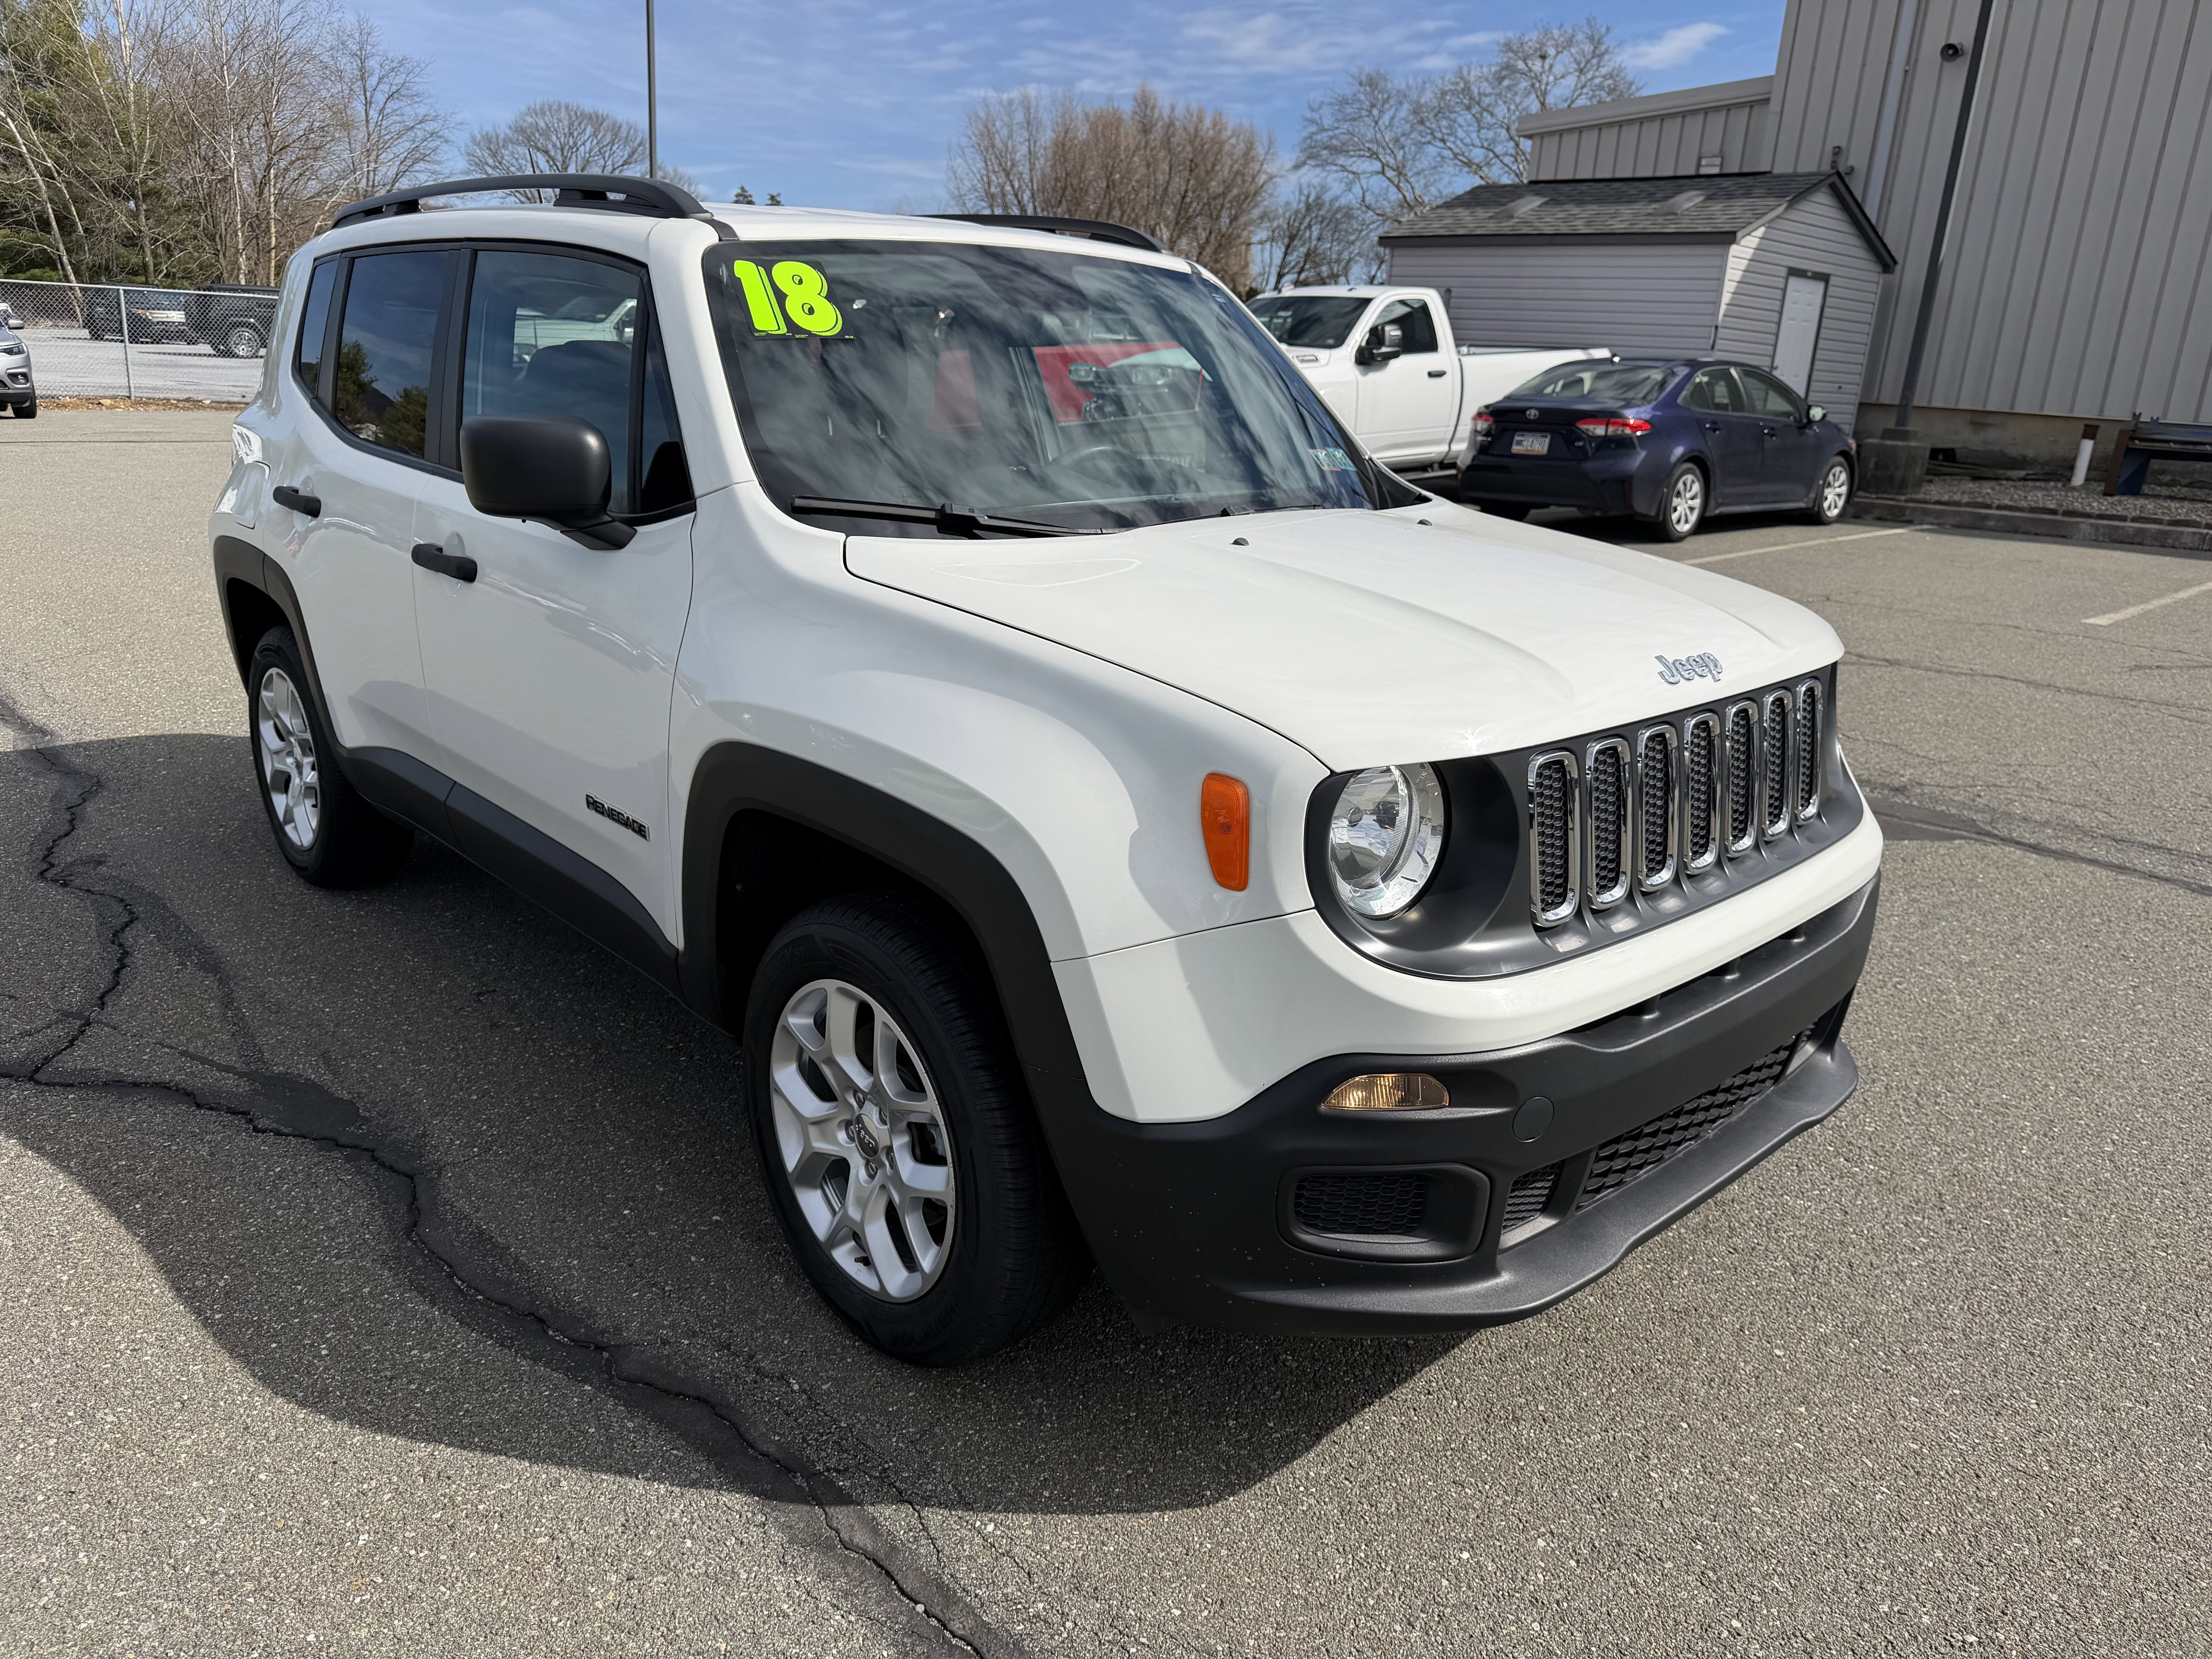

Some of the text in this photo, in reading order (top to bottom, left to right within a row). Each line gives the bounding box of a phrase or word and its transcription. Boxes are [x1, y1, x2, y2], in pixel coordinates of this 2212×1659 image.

[734, 260, 843, 336] 18
[1654, 653, 1723, 685] Jeep
[586, 792, 650, 842] RENEGADE
